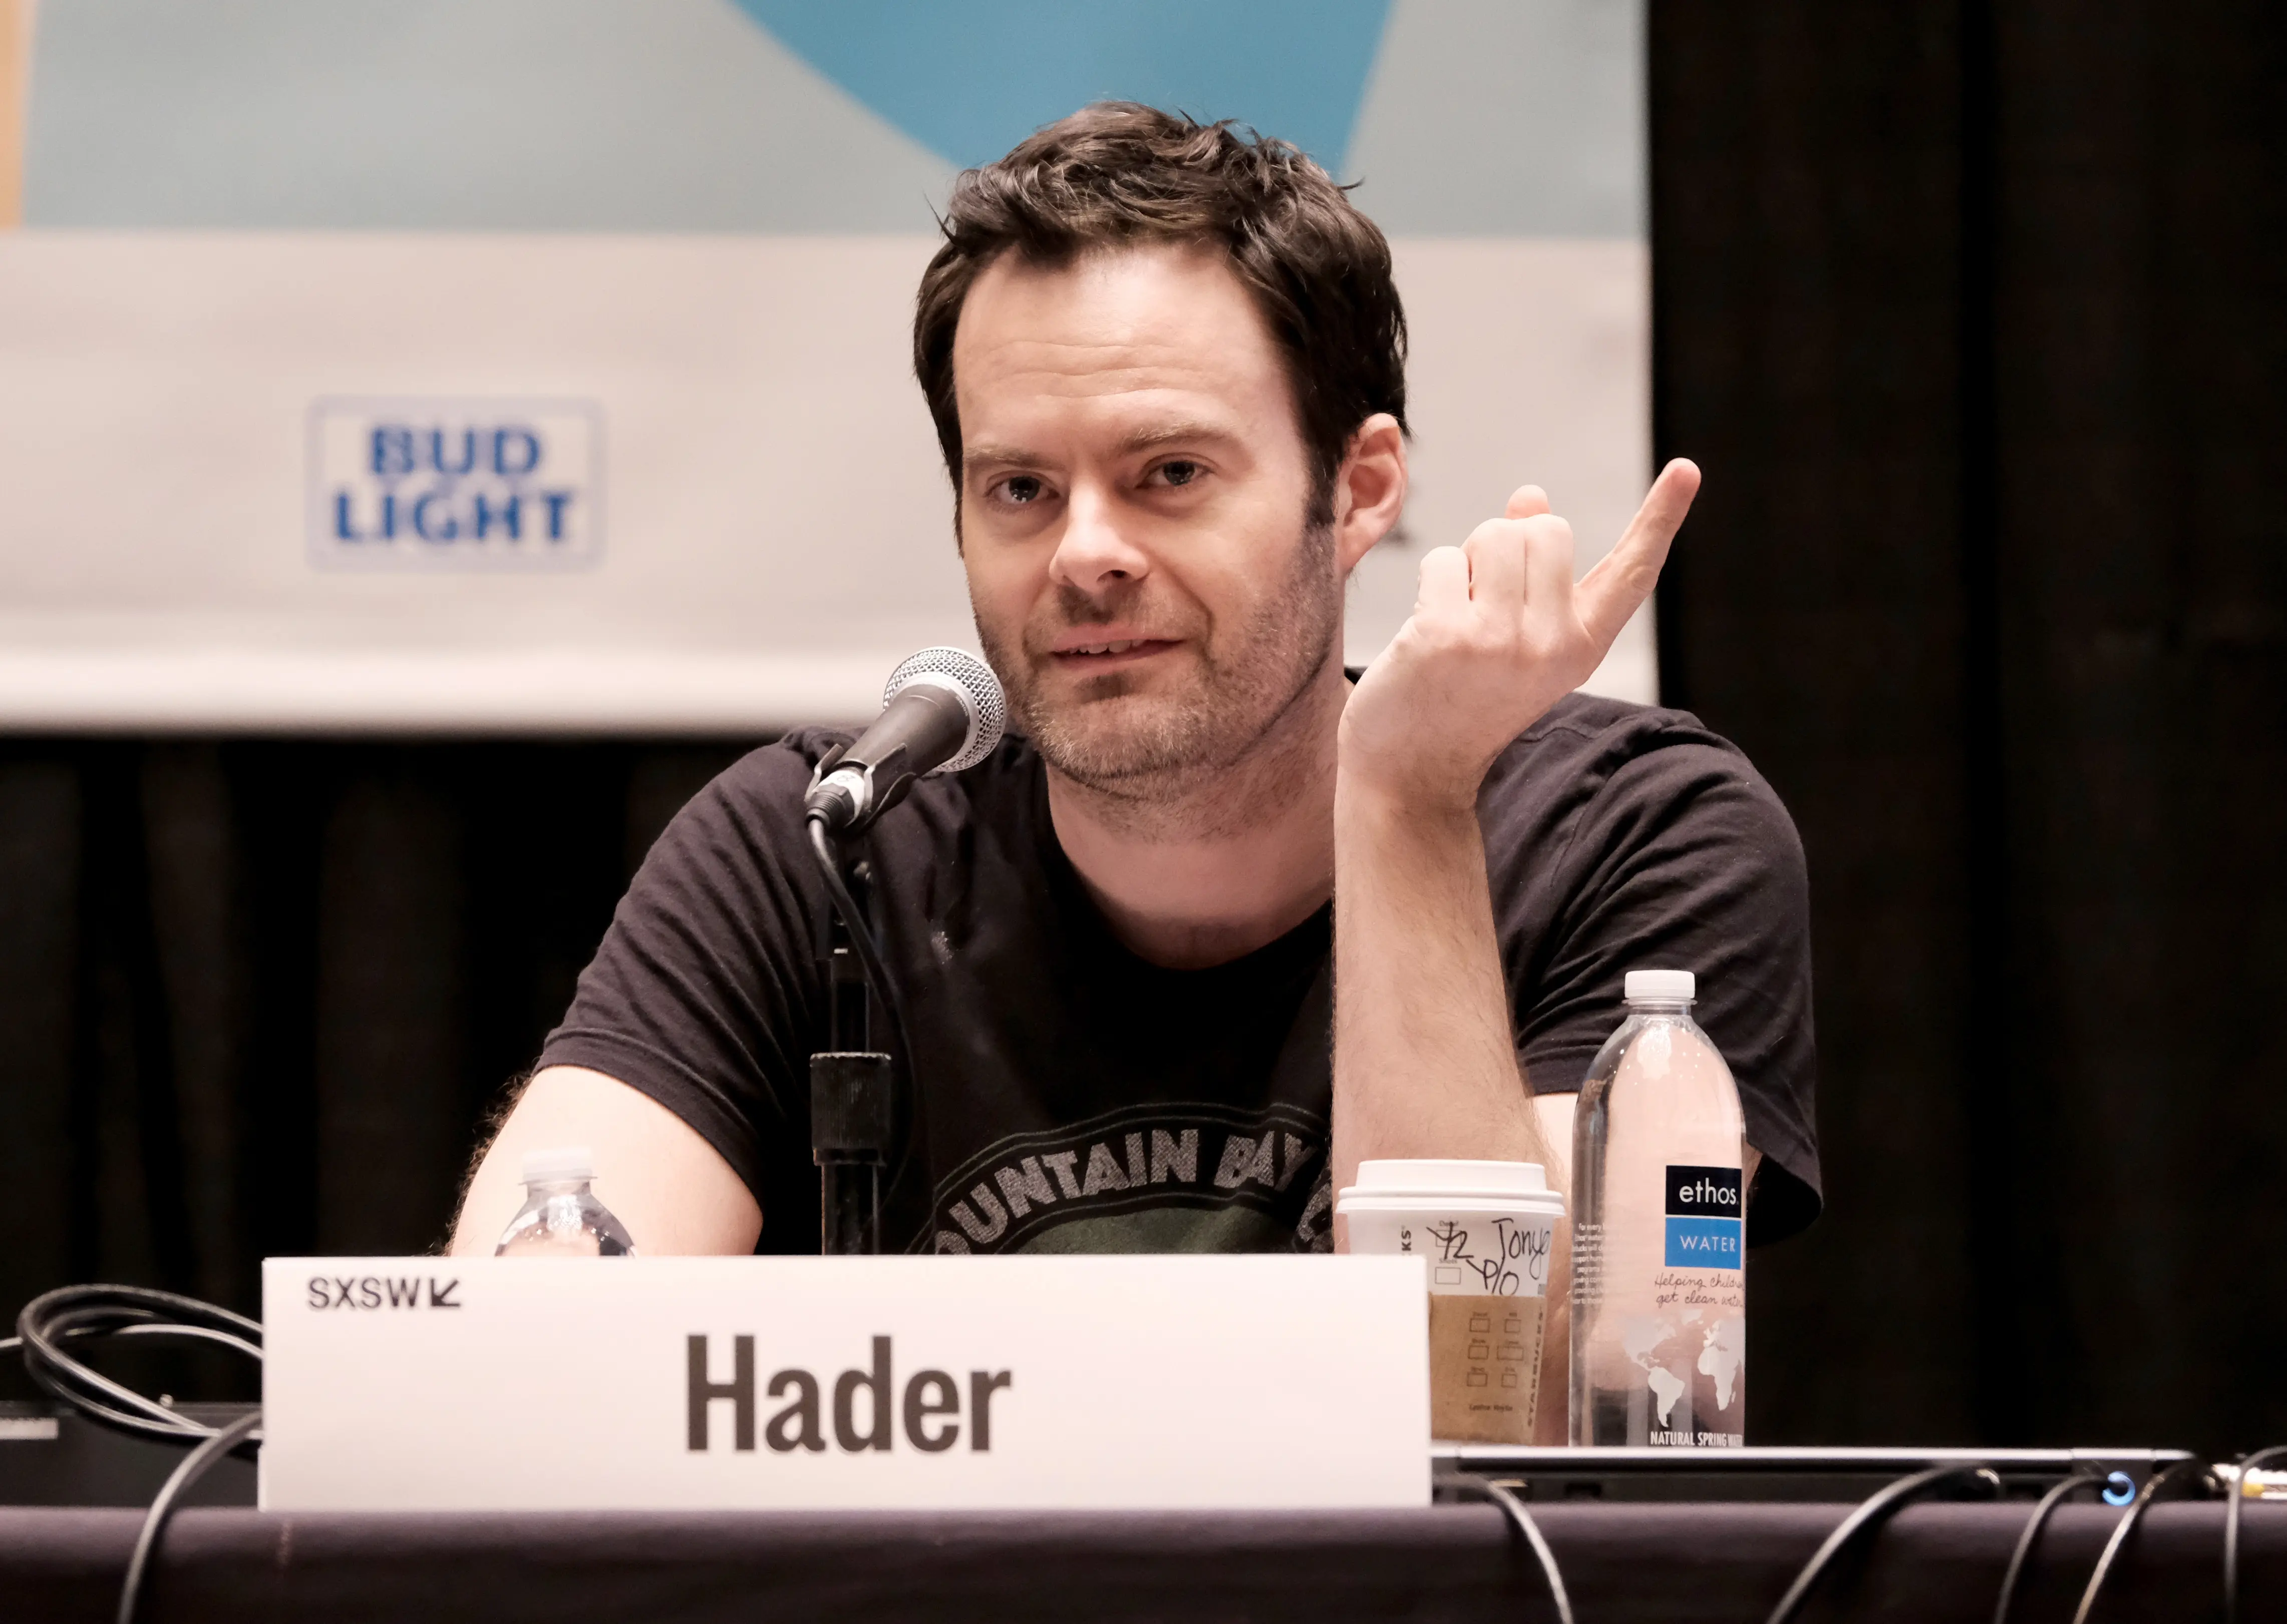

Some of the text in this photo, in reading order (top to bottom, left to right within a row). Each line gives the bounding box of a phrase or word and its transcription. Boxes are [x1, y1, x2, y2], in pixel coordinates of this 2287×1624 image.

[369, 426, 542, 476] BUD
[335, 491, 574, 542] LIGHT
[1213, 1130, 1319, 1193] BAY
[1679, 1177, 1737, 1205] ethos
[1680, 1235, 1736, 1252] WATER
[309, 1277, 420, 1309] SXSW
[1654, 1272, 1745, 1291] Helping childre
[1656, 1292, 1679, 1308] get
[1684, 1290, 1718, 1305] clean
[688, 1335, 1012, 1452] Hader
[1651, 1431, 1695, 1446] NATURAL
[1697, 1432, 1727, 1447] SPRING
